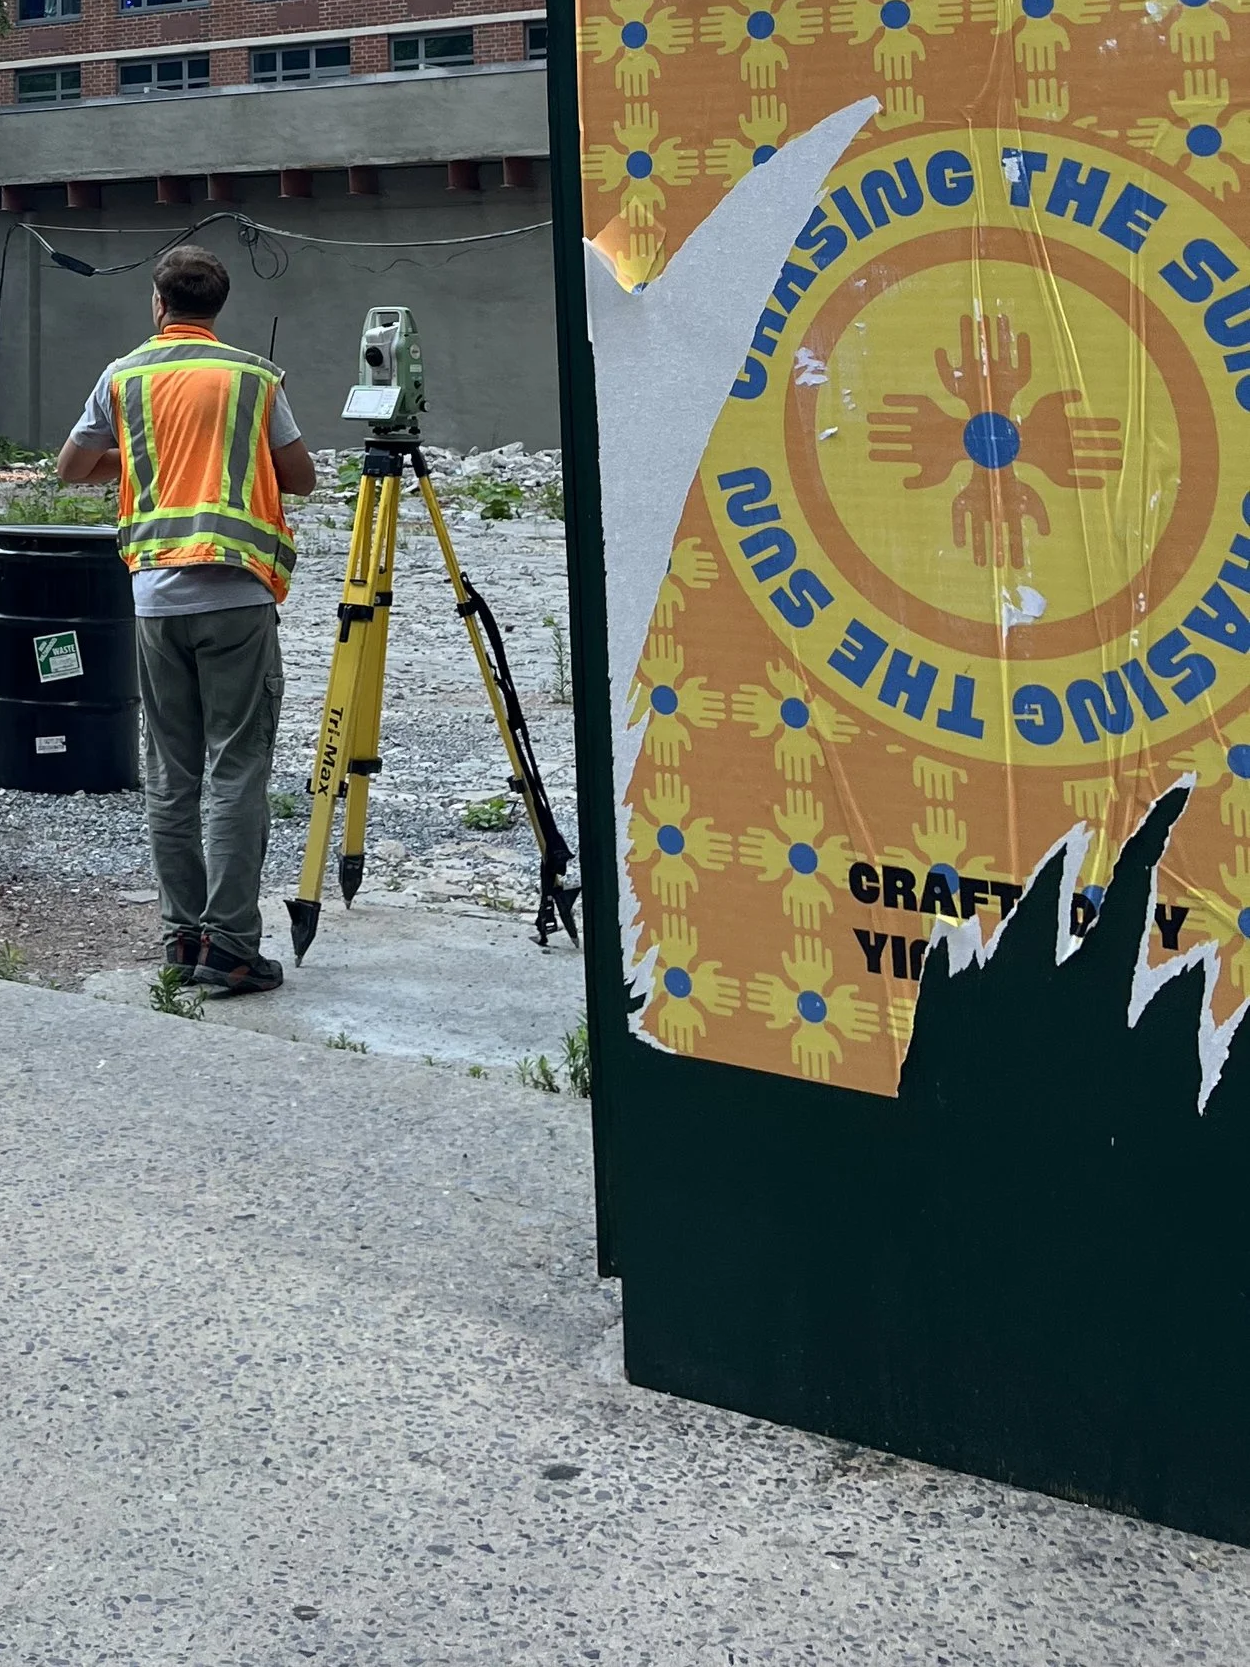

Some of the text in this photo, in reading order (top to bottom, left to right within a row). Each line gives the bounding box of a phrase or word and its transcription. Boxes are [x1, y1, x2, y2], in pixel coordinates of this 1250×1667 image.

[729, 149, 975, 400] CHASING
[1002, 147, 1168, 253] THE
[716, 466, 836, 629] SUN
[52, 644, 76, 656] WASTE
[827, 618, 986, 739] THE
[318, 707, 344, 797] Tri-Max
